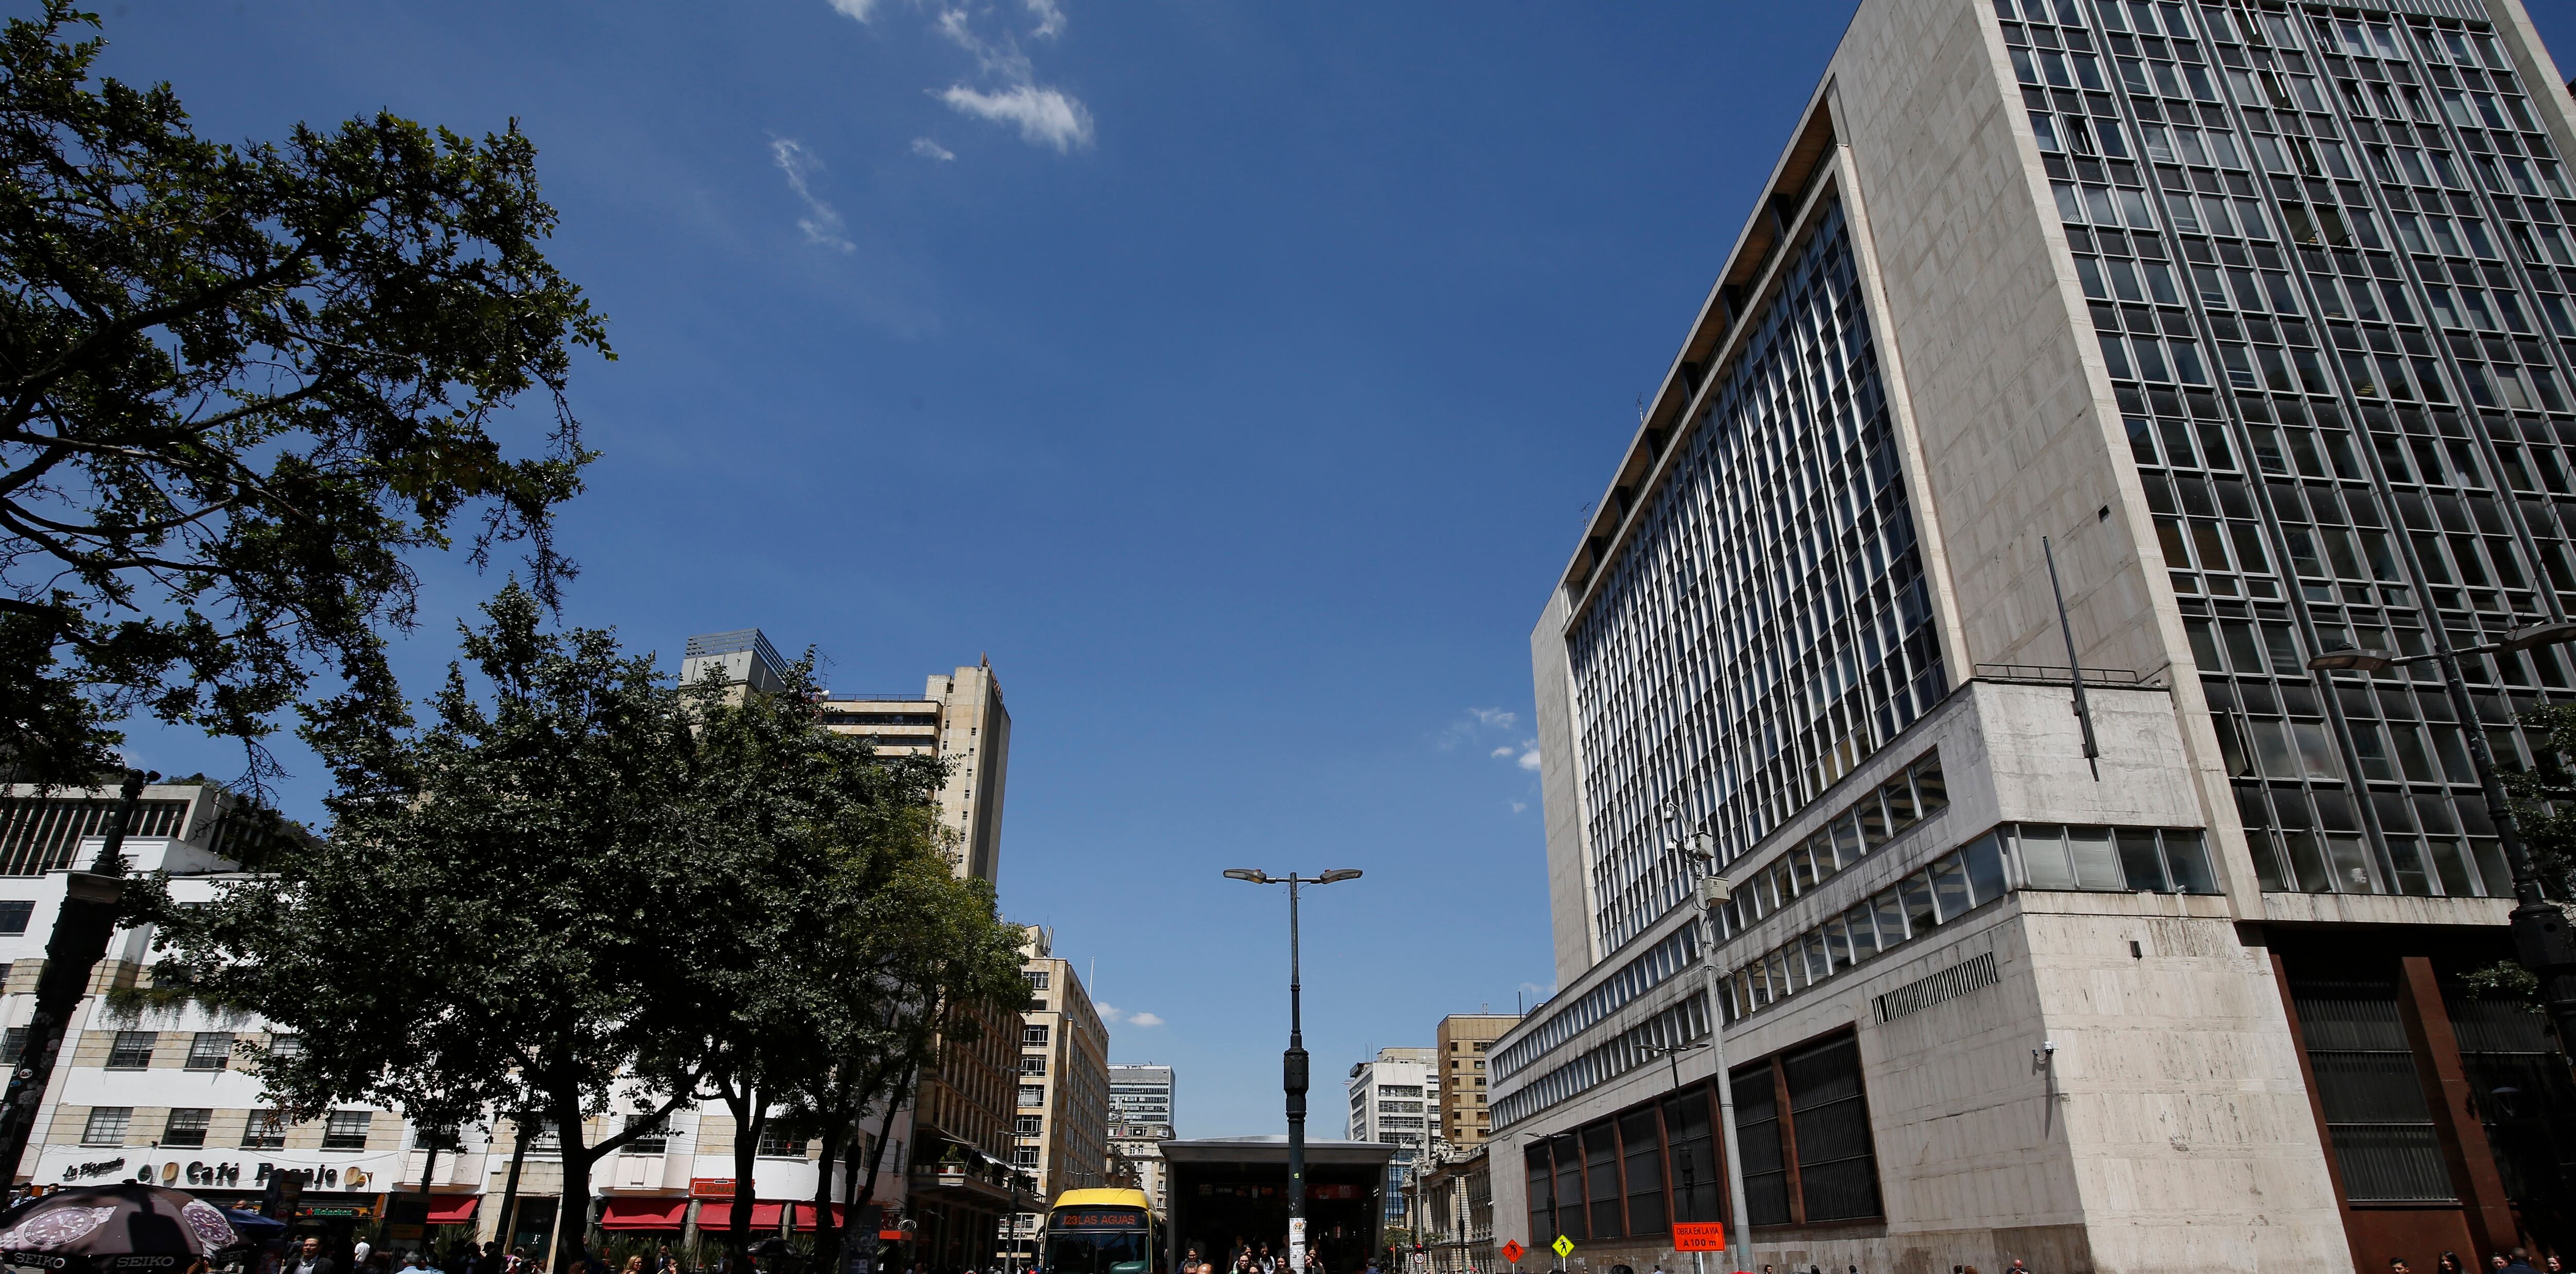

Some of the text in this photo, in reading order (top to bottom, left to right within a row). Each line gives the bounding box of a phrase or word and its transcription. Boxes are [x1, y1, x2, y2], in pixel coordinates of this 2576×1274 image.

[187, 1161, 337, 1184] Café Paje
[1078, 1216, 1097, 1225] LAS
[1101, 1215, 1136, 1225] AGUAS
[1690, 1238, 1706, 1247] 100
[14, 1253, 65, 1268] SEIKO
[116, 1256, 175, 1268] SEIKO
